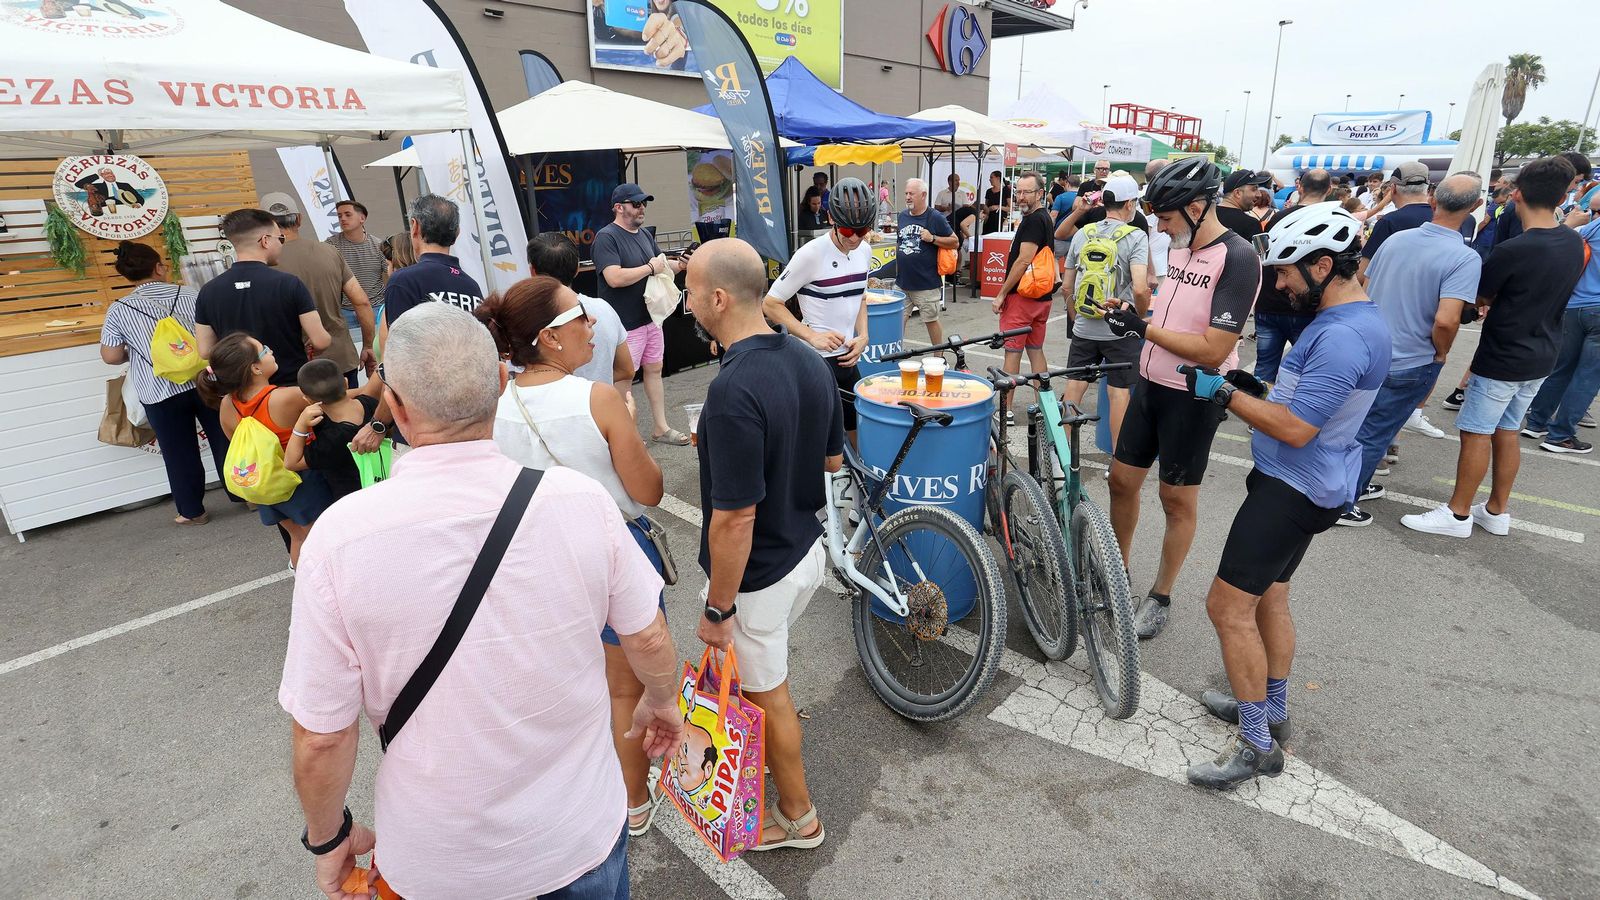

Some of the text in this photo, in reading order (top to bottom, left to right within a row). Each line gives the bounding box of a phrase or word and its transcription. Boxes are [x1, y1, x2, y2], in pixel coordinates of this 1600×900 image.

[25, 14, 168, 34] VICTORIA
[737, 11, 812, 35] todos los días
[158, 81, 366, 110] VICTORIA
[1337, 123, 1397, 132] LACTALIS
[64, 155, 149, 183] CERVEZAS
[520, 163, 574, 186] IVES
[81, 206, 158, 233] VICTORIA
[885, 514, 919, 531] MAXXIS
